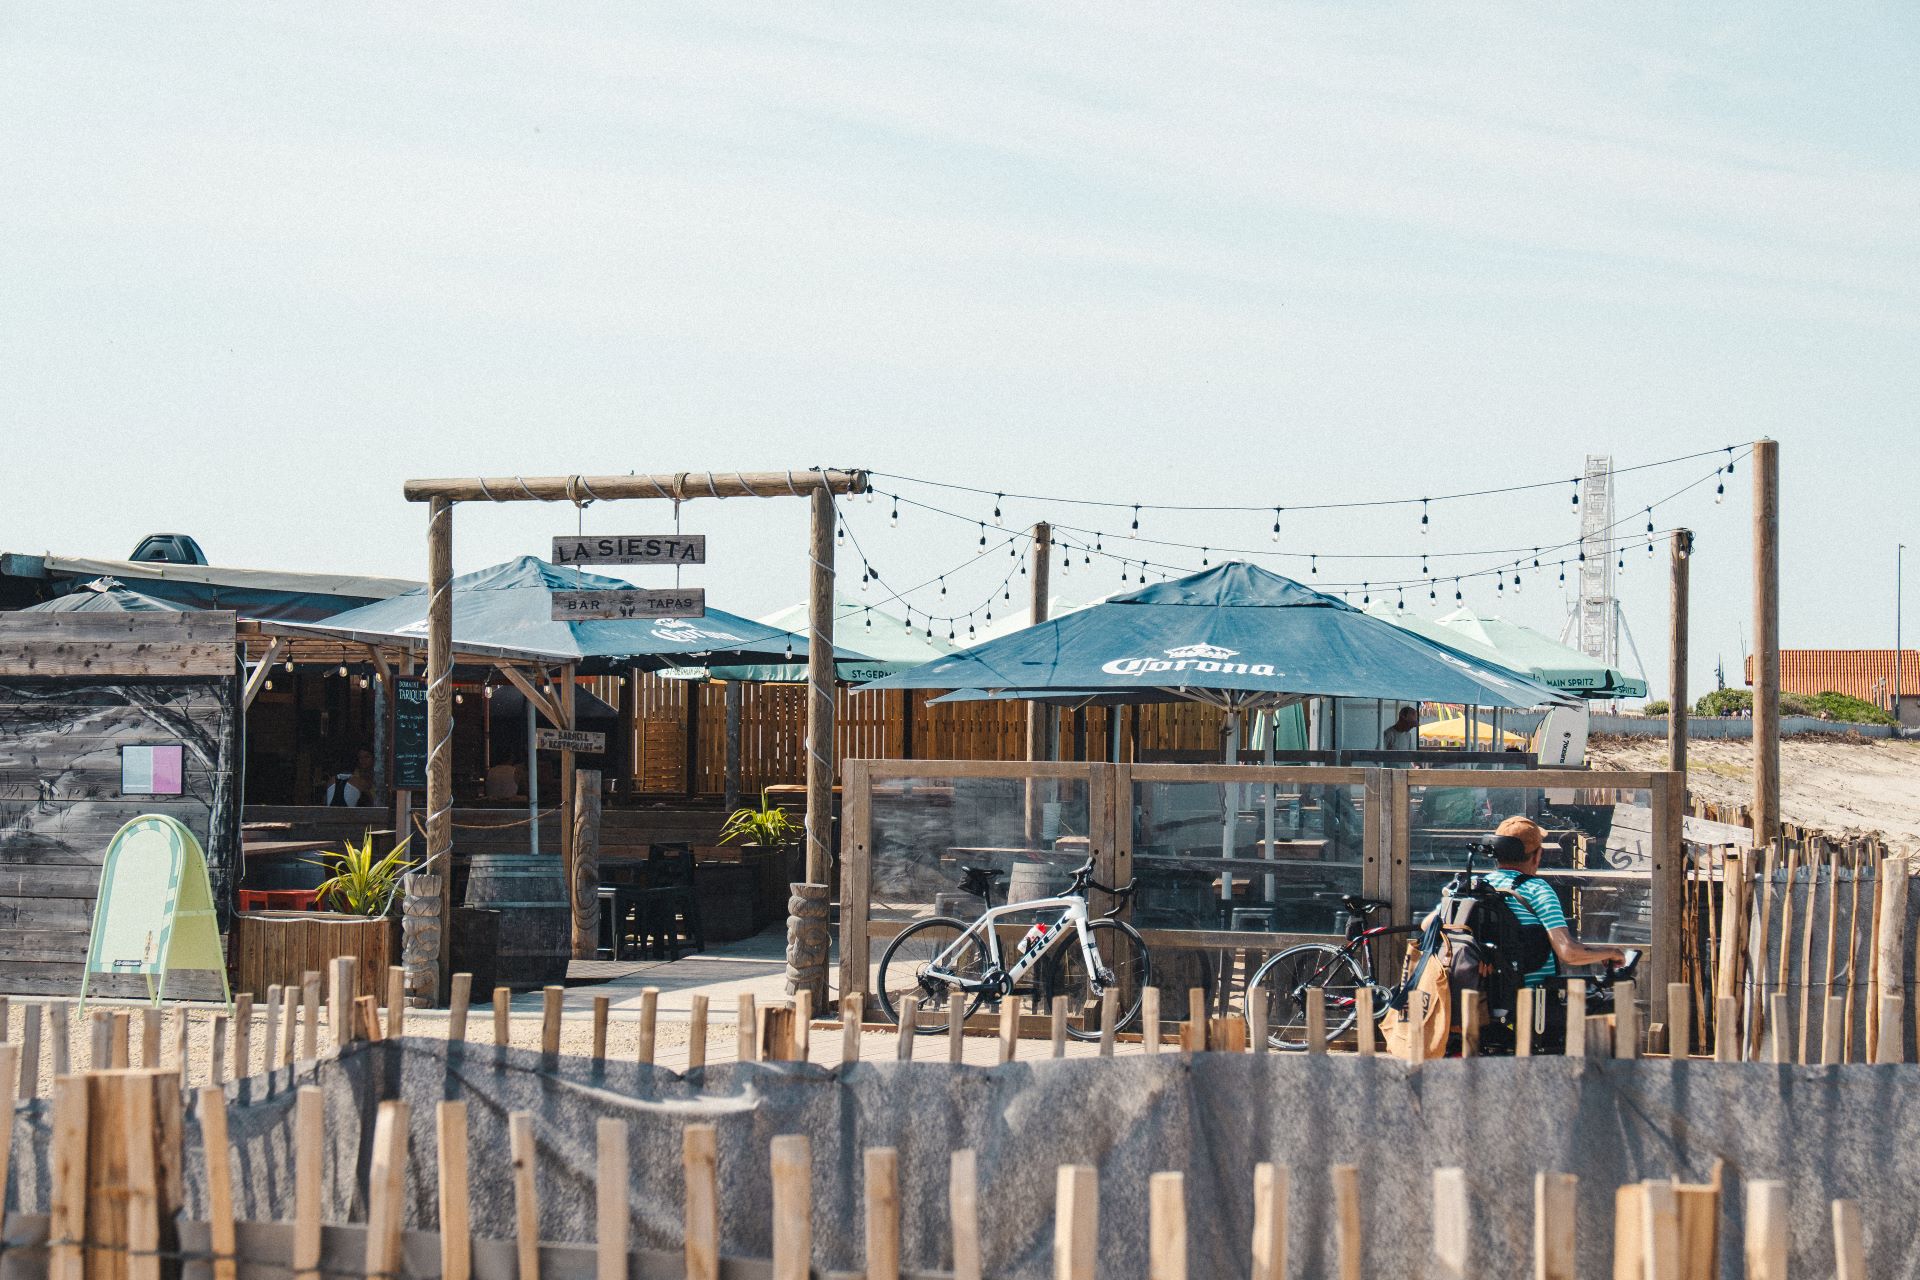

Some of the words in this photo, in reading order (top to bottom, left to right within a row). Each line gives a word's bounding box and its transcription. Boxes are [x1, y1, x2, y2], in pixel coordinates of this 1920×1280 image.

[558, 542, 591, 563] LA
[598, 538, 697, 561] SIESTA
[568, 600, 600, 610] BAR
[648, 598, 692, 609] TAPAS
[852, 669, 896, 679] ST-GERM
[1101, 657, 1275, 676] Corona
[1567, 678, 1594, 687] SPRITZ
[1020, 915, 1070, 969] TREK
